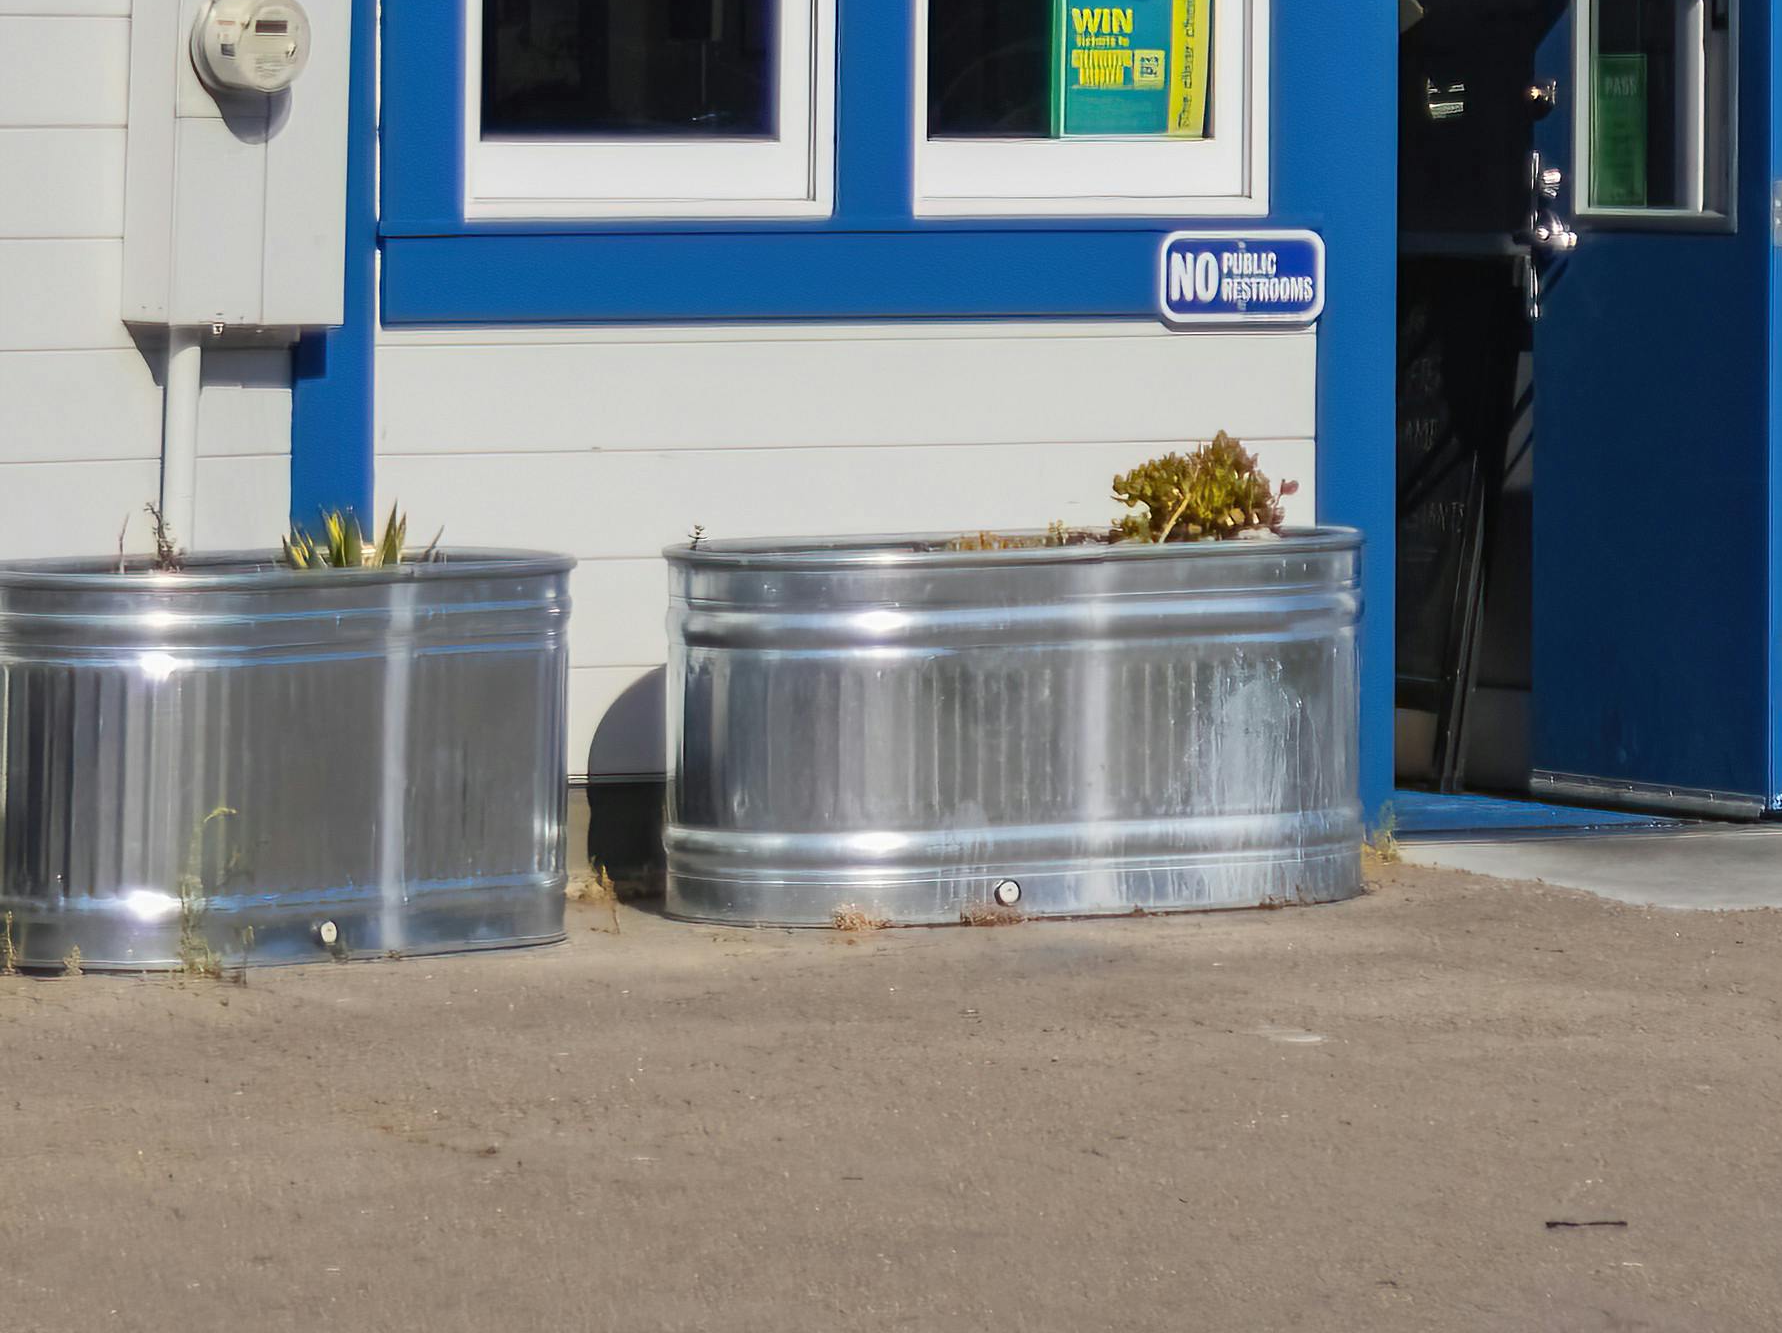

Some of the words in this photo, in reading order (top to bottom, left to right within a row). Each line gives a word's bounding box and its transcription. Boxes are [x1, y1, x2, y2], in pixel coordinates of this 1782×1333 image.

[1071, 7, 1133, 34] WIN
[1170, 251, 1219, 303] NO
[1221, 251, 1277, 276] PUBLIC
[1221, 276, 1313, 303] RESTROOMS
